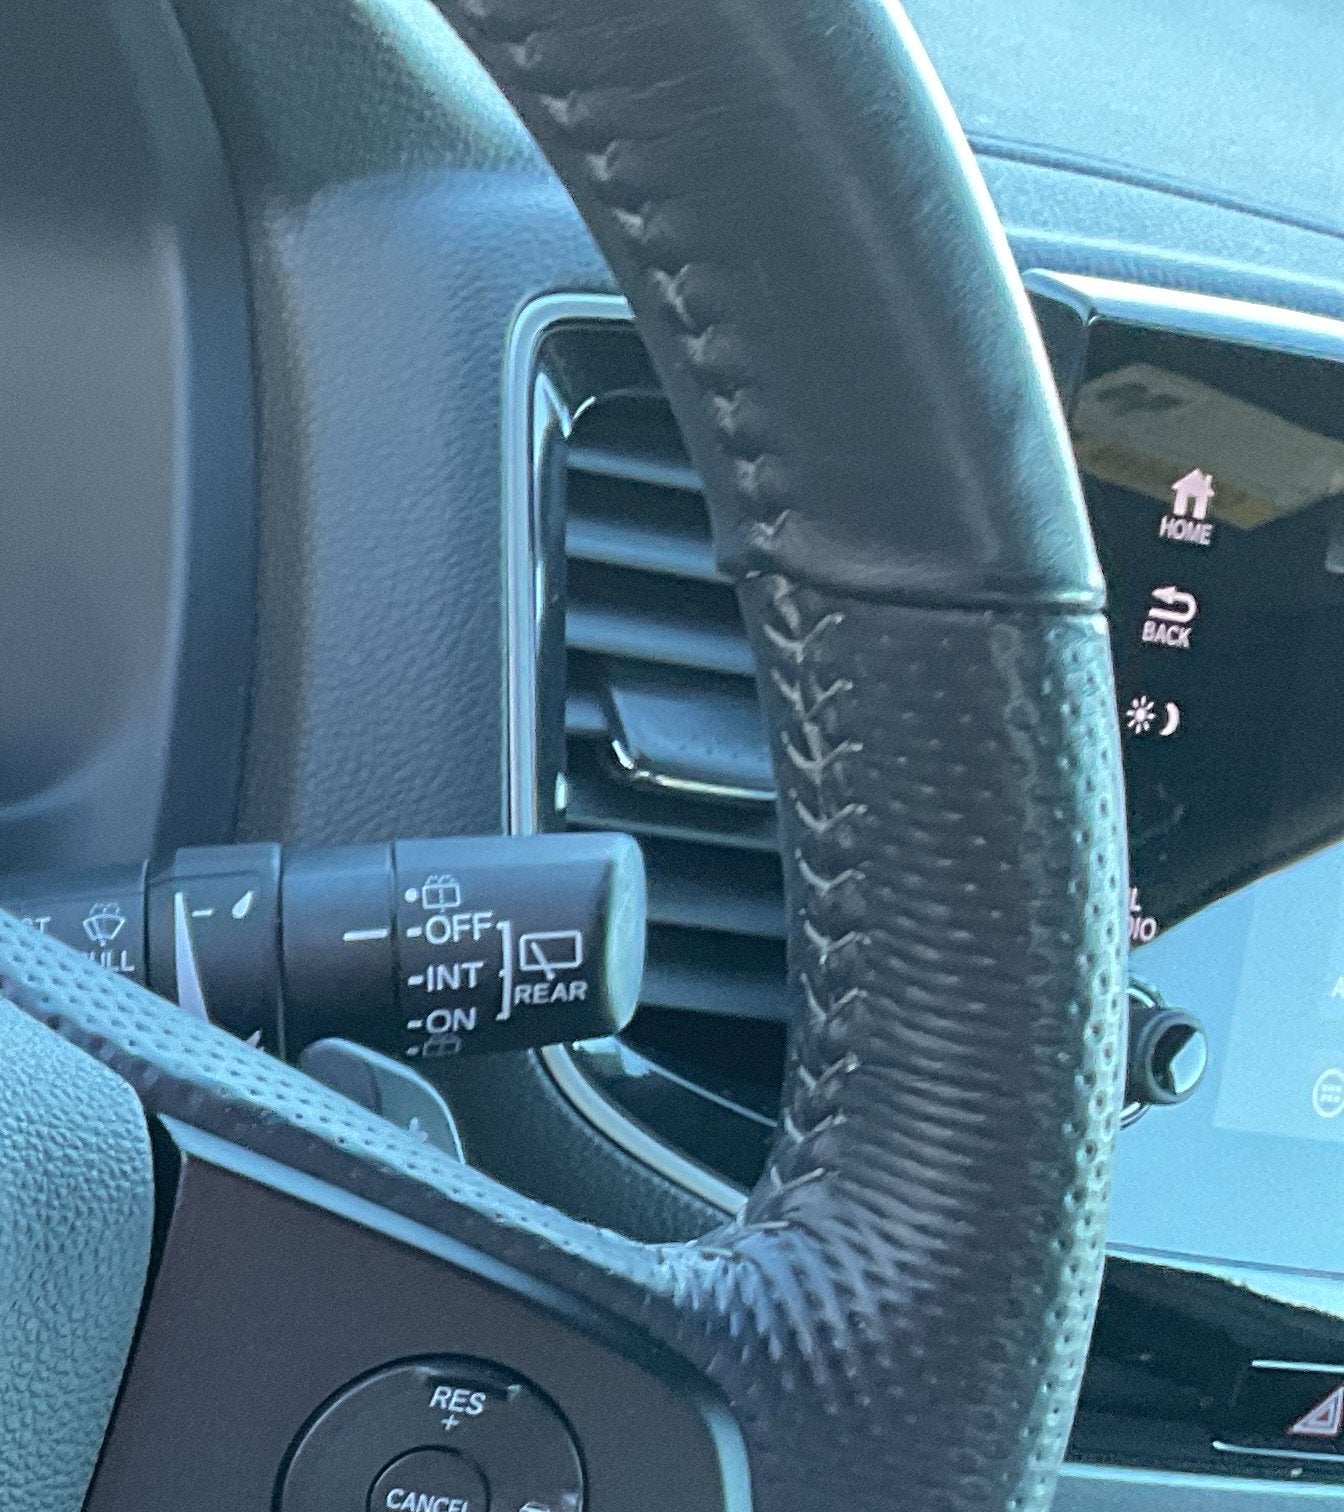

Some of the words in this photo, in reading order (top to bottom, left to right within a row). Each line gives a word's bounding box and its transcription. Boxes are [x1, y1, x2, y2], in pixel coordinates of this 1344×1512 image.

[1158, 514, 1213, 546] HOME
[1141, 619, 1193, 649] BACK
[425, 909, 494, 945] OFF
[426, 960, 485, 993] INT
[514, 980, 588, 1007] REAR
[425, 1006, 478, 1034] ON
[428, 1384, 487, 1416] RES
